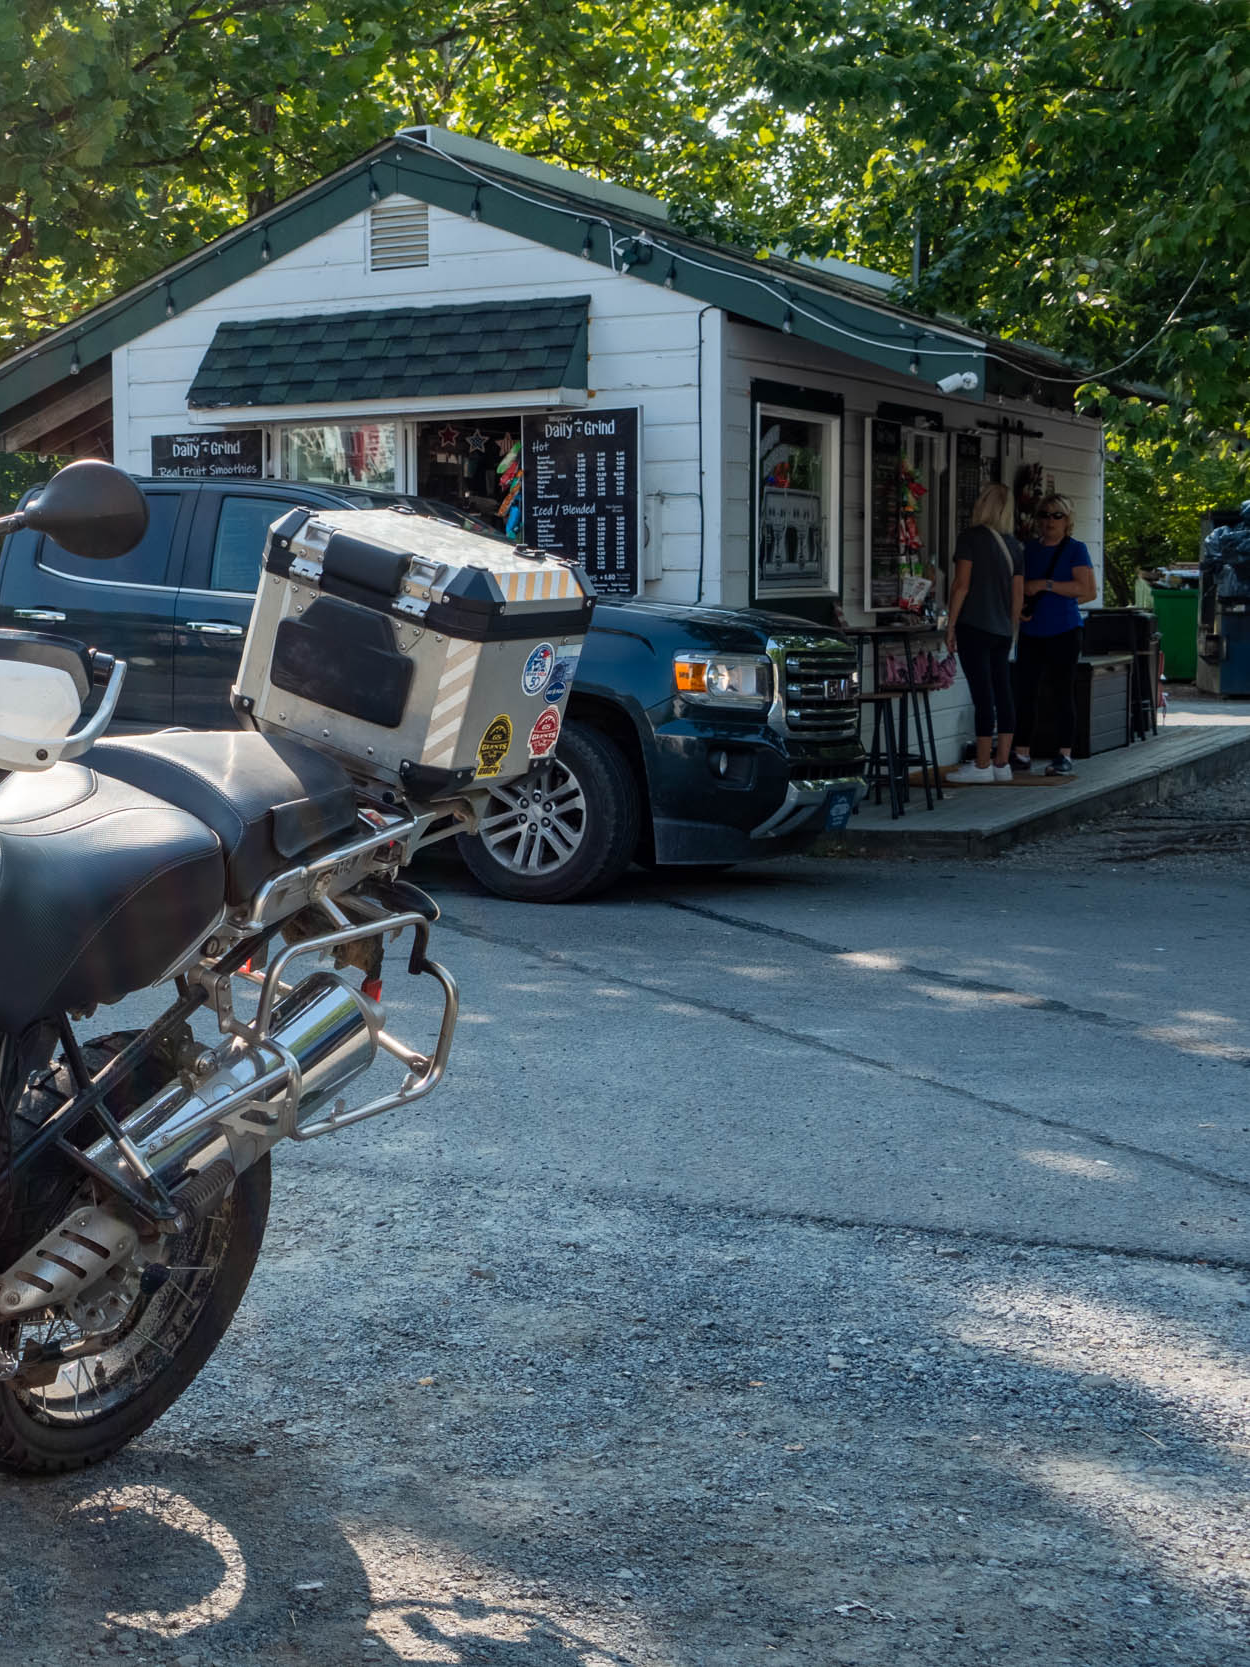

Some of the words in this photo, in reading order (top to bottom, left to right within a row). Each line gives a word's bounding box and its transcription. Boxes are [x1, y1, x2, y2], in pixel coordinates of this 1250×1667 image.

[545, 423, 573, 439] Daily
[584, 419, 615, 436] Grind
[172, 442, 200, 458] Daily
[210, 441, 241, 456] Grind
[531, 440, 550, 453] Hot
[158, 465, 180, 477] Real
[182, 465, 207, 477] Fruit
[208, 463, 258, 476] Smoothies
[532, 504, 553, 517] Iced
[561, 503, 596, 516] Blended
